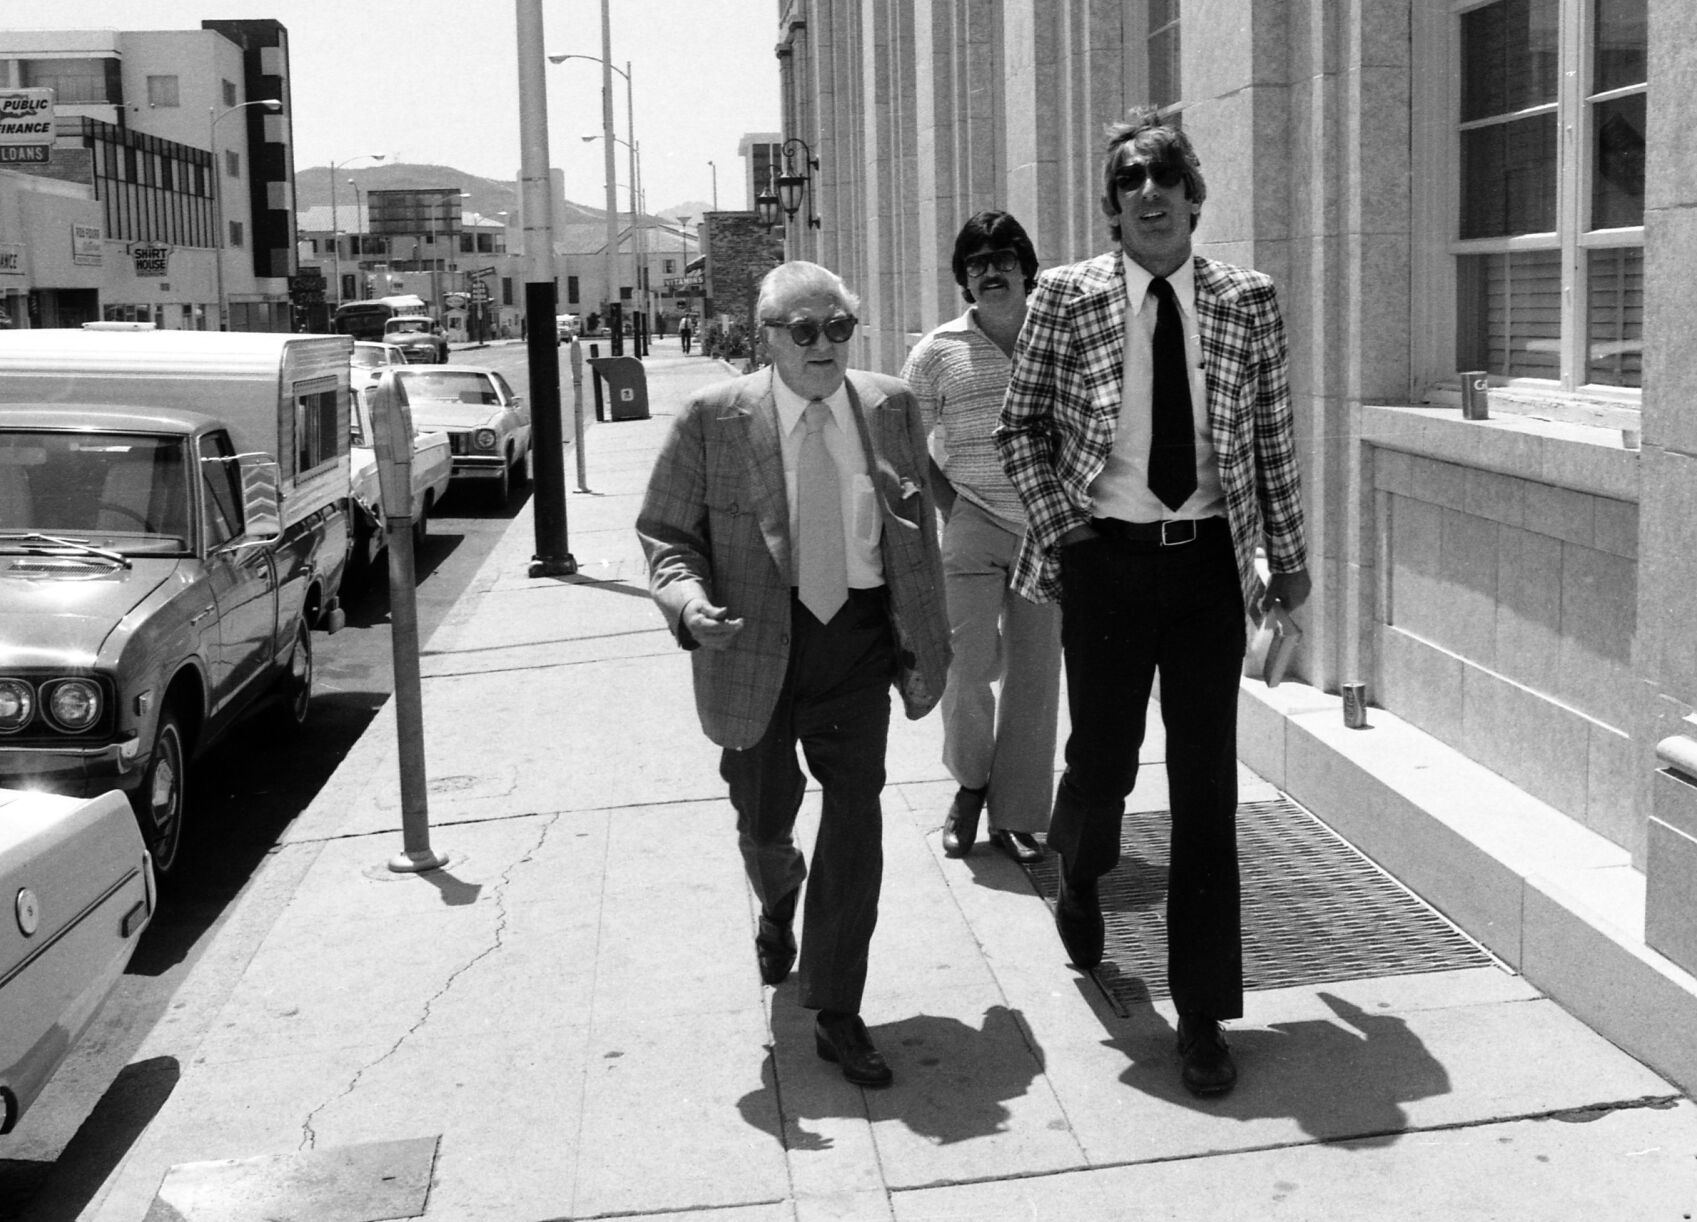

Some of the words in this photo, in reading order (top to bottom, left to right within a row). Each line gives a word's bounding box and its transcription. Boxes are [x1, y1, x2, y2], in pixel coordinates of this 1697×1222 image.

[3, 99, 48, 110] PUBLIC
[1, 147, 43, 160] LOANS
[136, 259, 166, 270] HOUSE
[665, 277, 703, 287] VITAMINS
